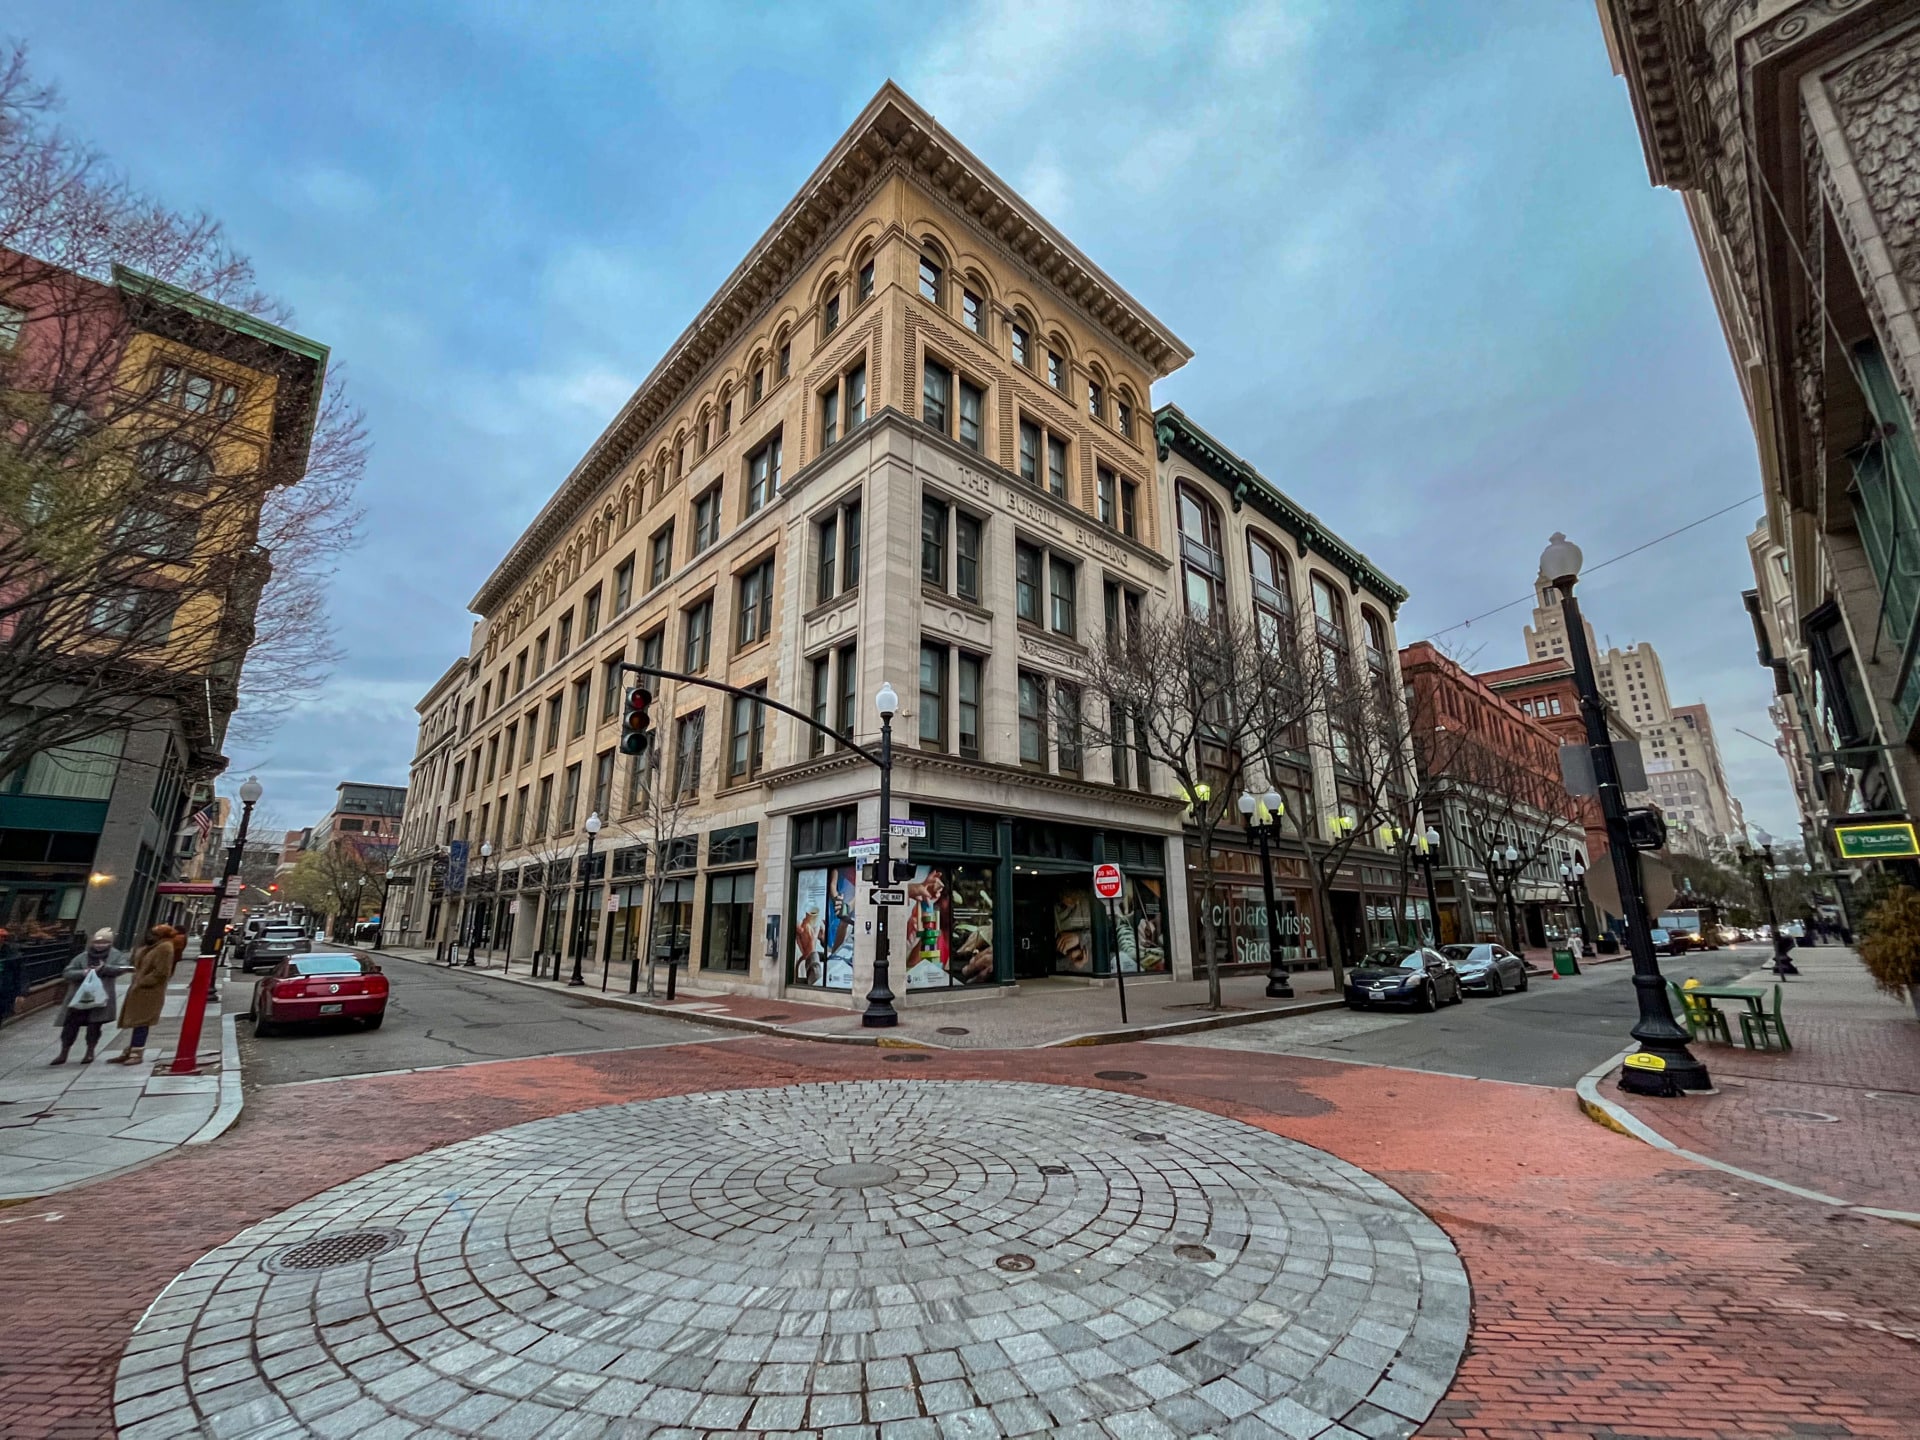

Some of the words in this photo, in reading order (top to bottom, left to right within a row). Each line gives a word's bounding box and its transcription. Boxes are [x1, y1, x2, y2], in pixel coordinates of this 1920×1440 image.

[958, 467, 990, 497] THE
[1006, 490, 1063, 535] BURRILL
[1074, 527, 1128, 568] BUILDING
[890, 825, 921, 836] WESTMINSTER
[1235, 935, 1272, 963] Stars
